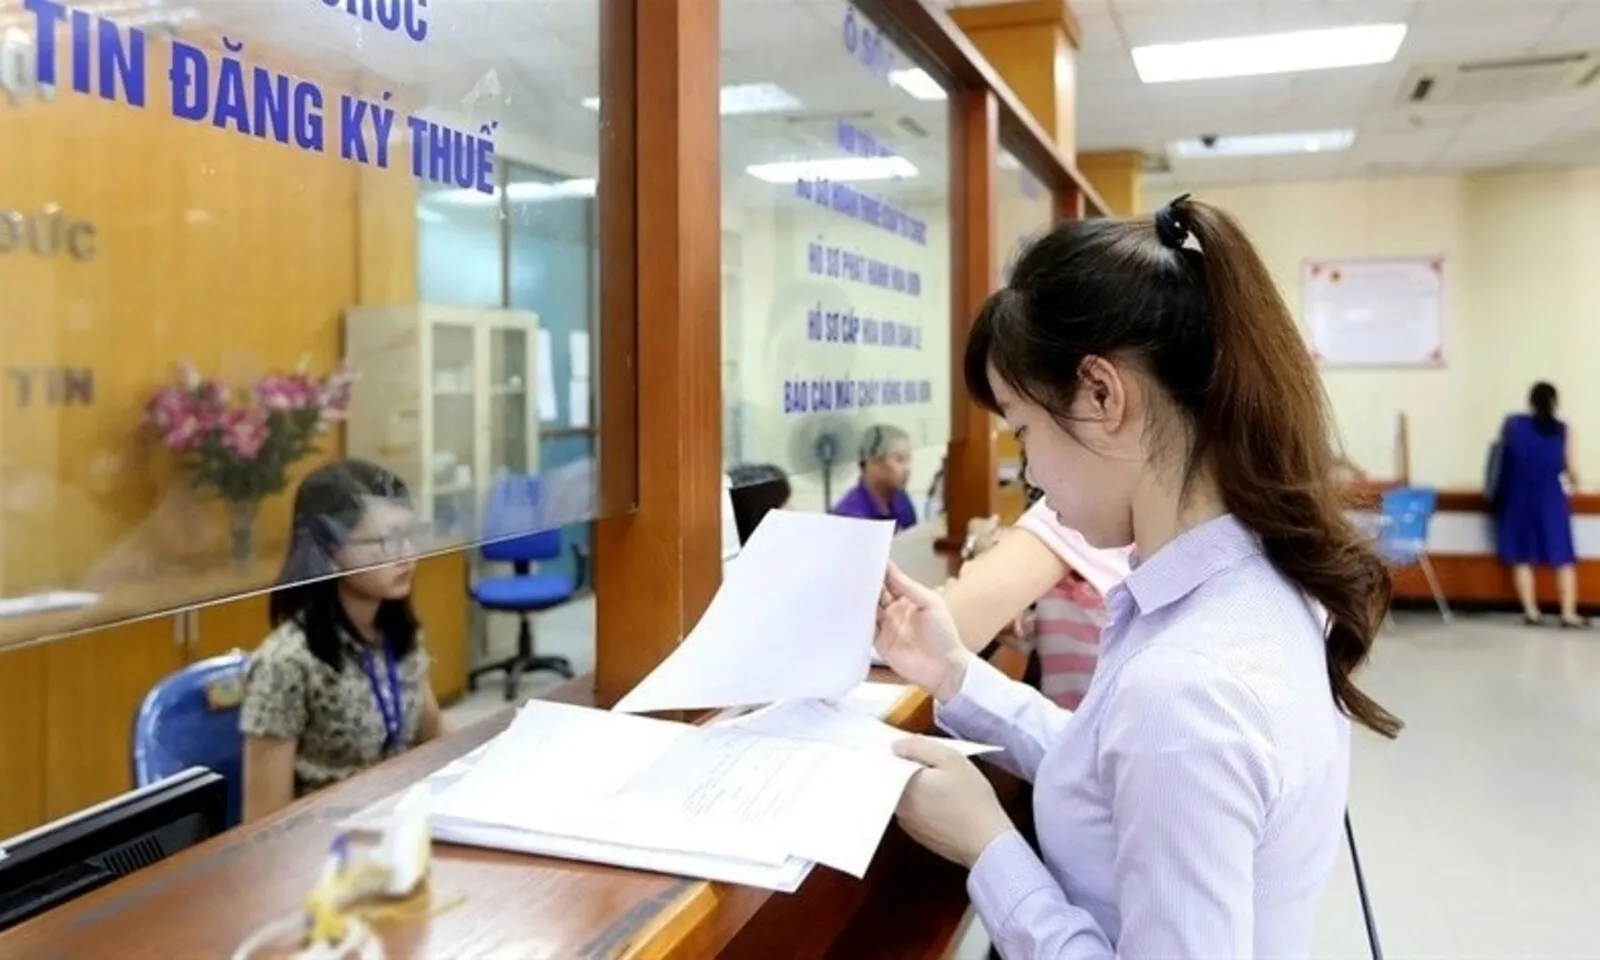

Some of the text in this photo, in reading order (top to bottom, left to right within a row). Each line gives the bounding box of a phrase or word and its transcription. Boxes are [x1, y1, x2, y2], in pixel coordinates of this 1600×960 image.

[23, 0, 146, 108] TIN
[169, 36, 324, 153] ĐĂNG
[340, 92, 395, 169] KÝ
[407, 116, 499, 197] THUẾ
